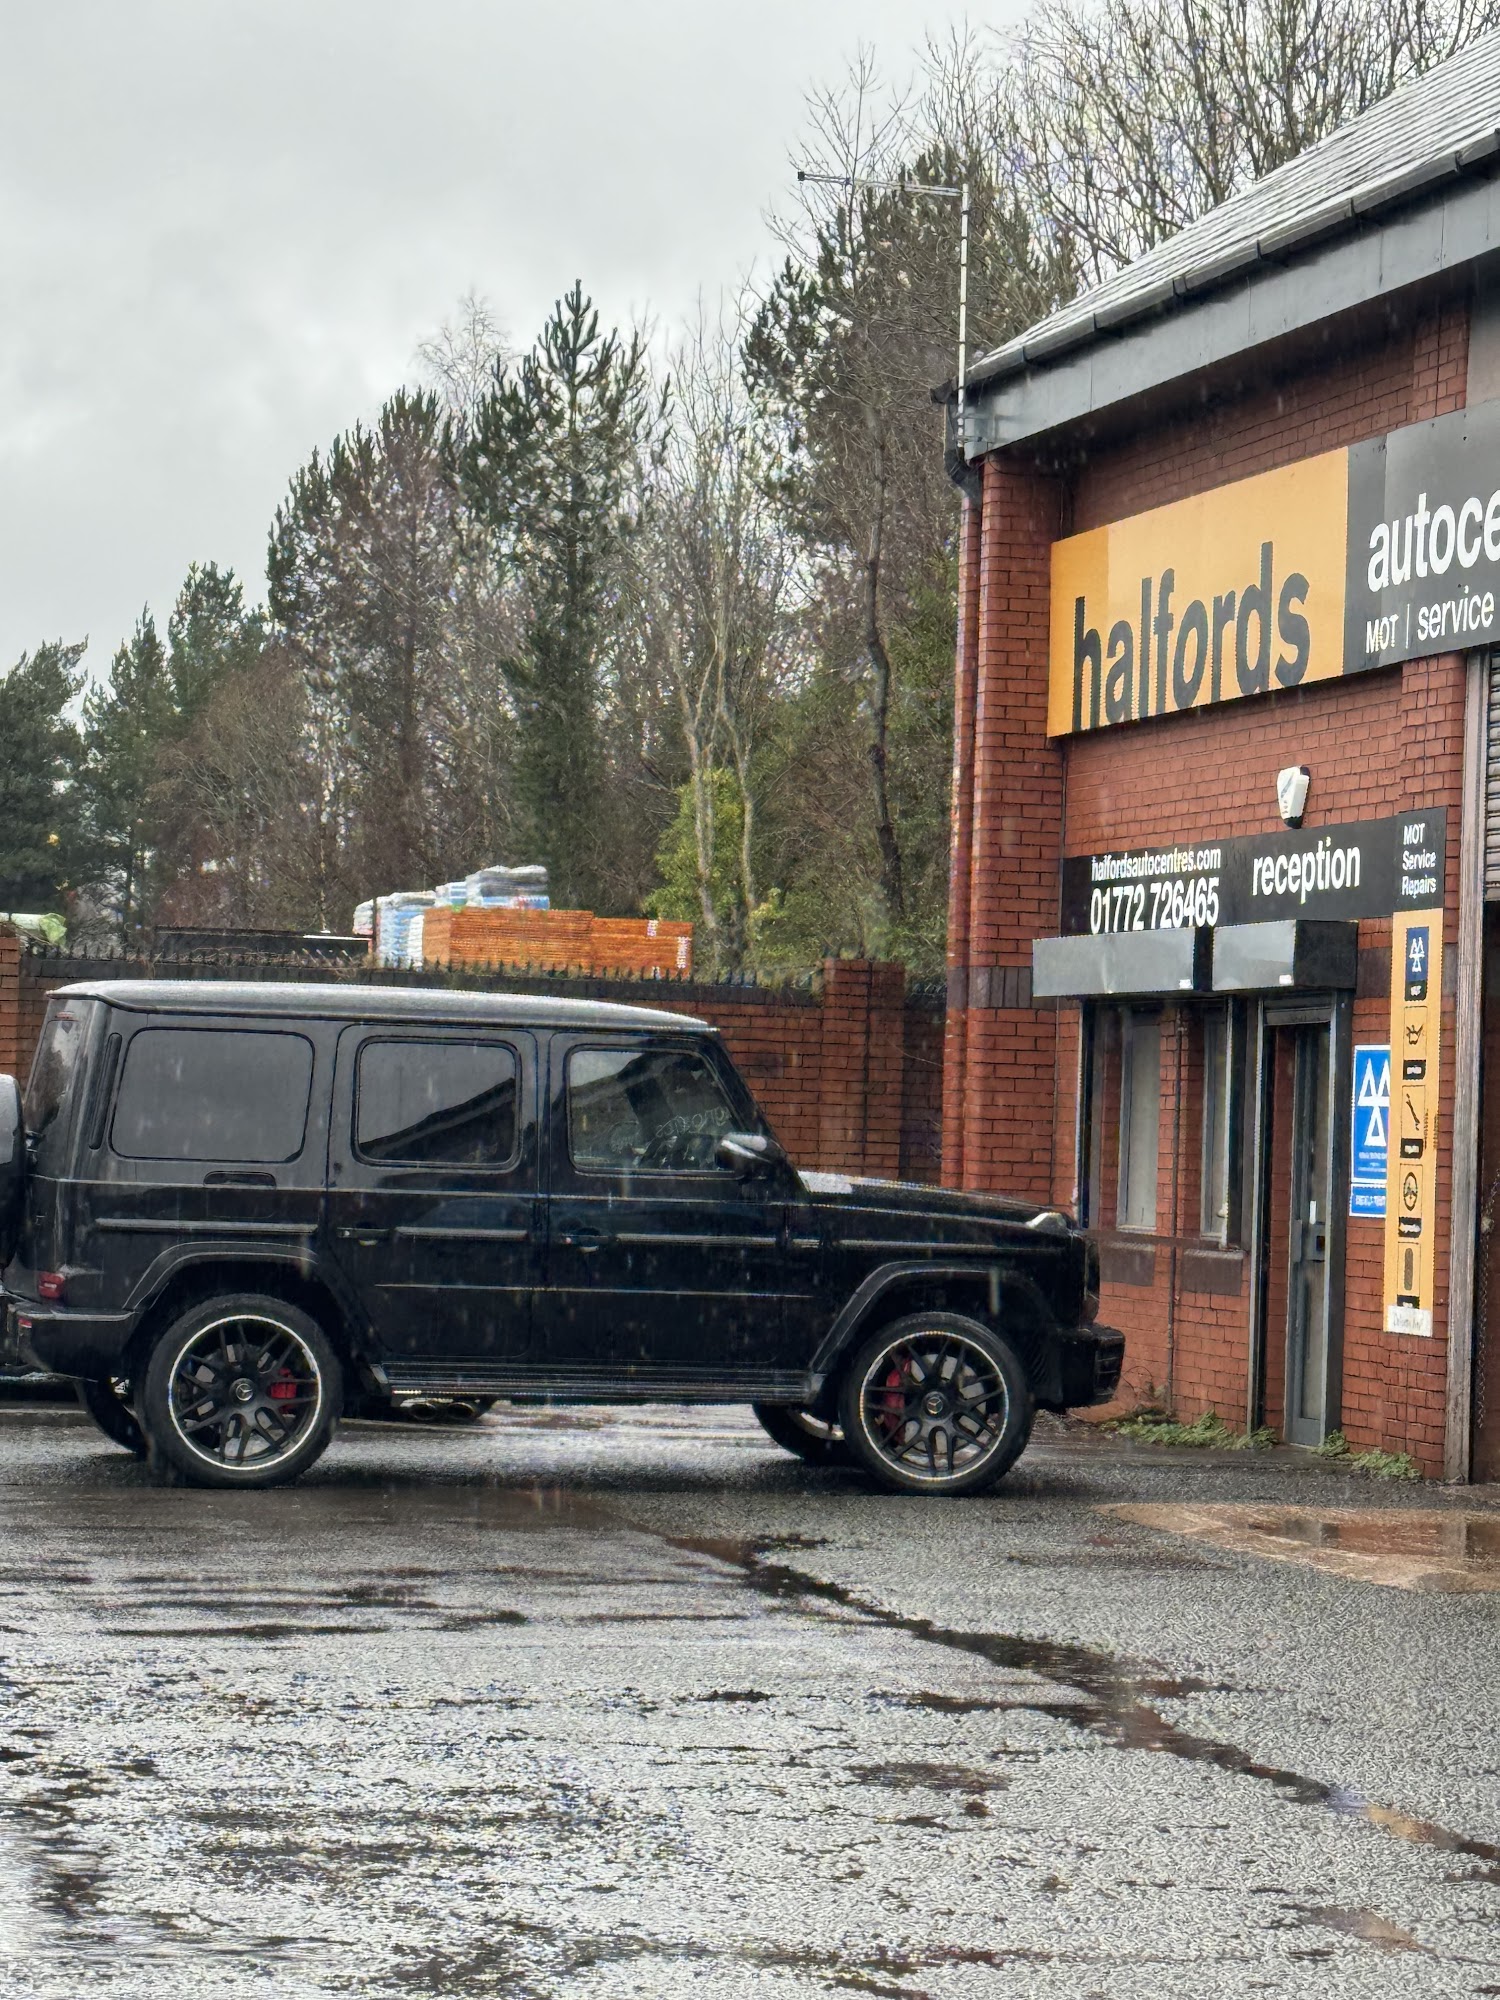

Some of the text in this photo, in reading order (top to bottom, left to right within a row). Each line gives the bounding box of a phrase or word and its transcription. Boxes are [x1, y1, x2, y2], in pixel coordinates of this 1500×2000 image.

[1072, 541, 1311, 732] halfords
[1366, 585, 1495, 653] MOT service
[1403, 823, 1425, 845] MOT
[1091, 847, 1221, 881] halfordsautocentres.com
[1252, 836, 1360, 905] reception
[1402, 849, 1436, 870] Service
[1090, 877, 1219, 935] 01772 726465
[1402, 874, 1436, 899] Repairs
